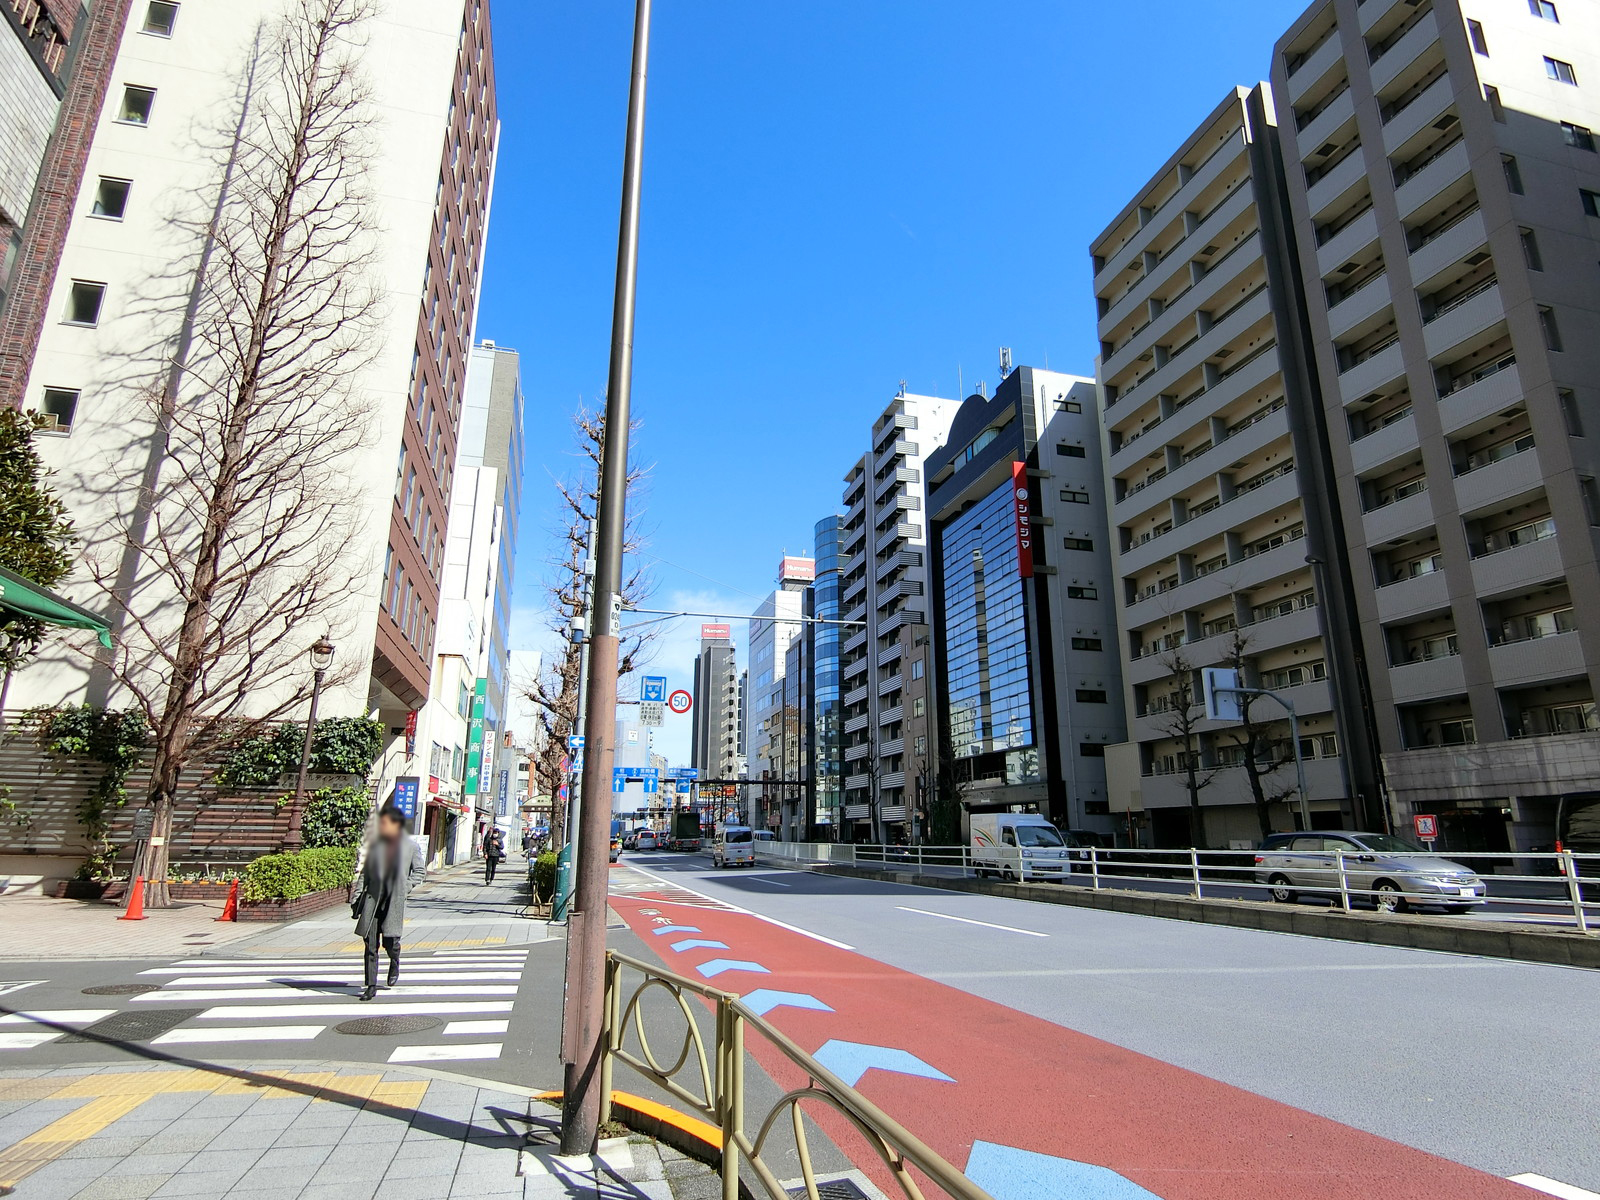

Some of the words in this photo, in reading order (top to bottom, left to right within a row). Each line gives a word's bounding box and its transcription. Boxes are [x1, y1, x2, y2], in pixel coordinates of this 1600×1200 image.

[1019, 504, 1030, 549] シモジマ
[673, 696, 687, 707] 50
[467, 694, 485, 778] 西沢商事
